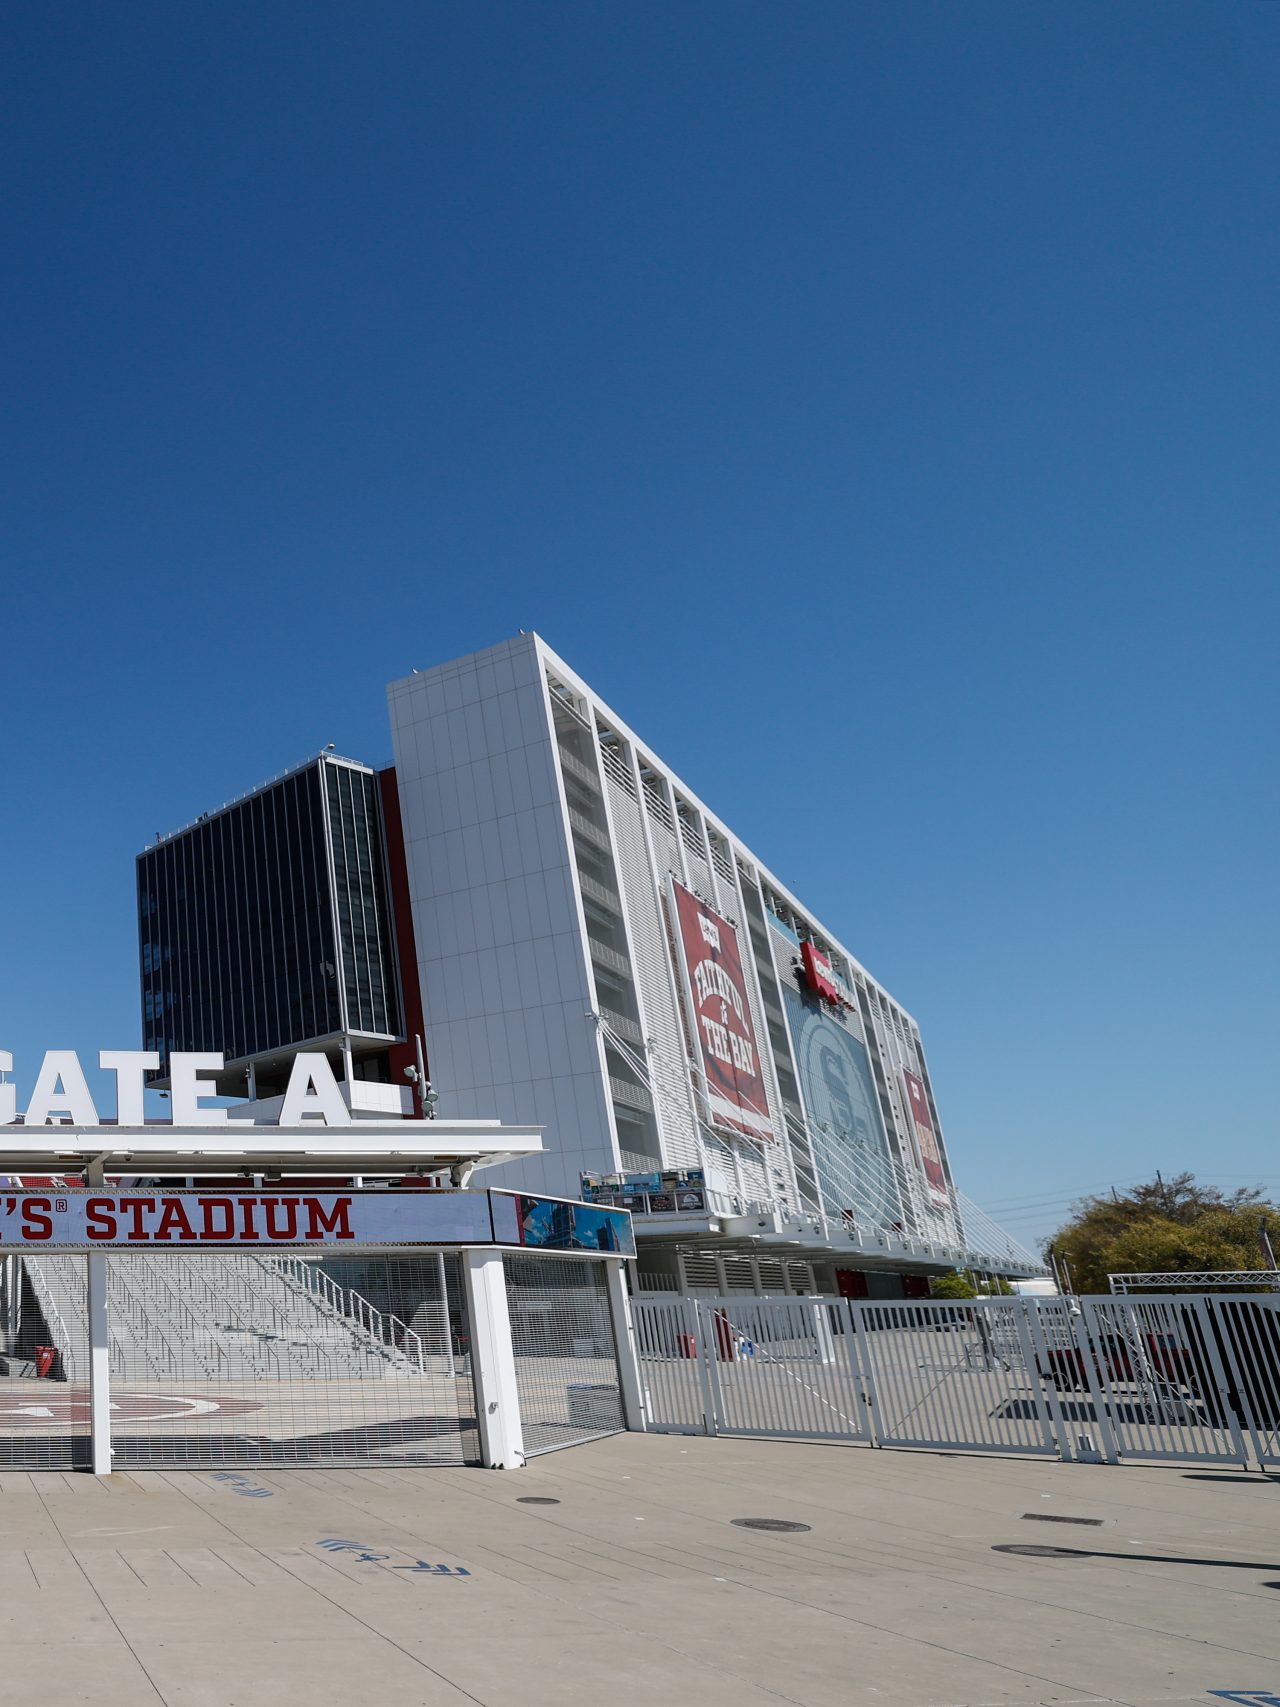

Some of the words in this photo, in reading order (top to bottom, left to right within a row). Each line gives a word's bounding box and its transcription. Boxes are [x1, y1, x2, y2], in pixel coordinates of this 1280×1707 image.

[694, 959, 751, 1038] FAITHFUL
[701, 1014, 732, 1065] THE
[728, 1030, 756, 1078] BAY
[278, 1052, 353, 1126] A
[85, 1197, 355, 1240] STADIUM
